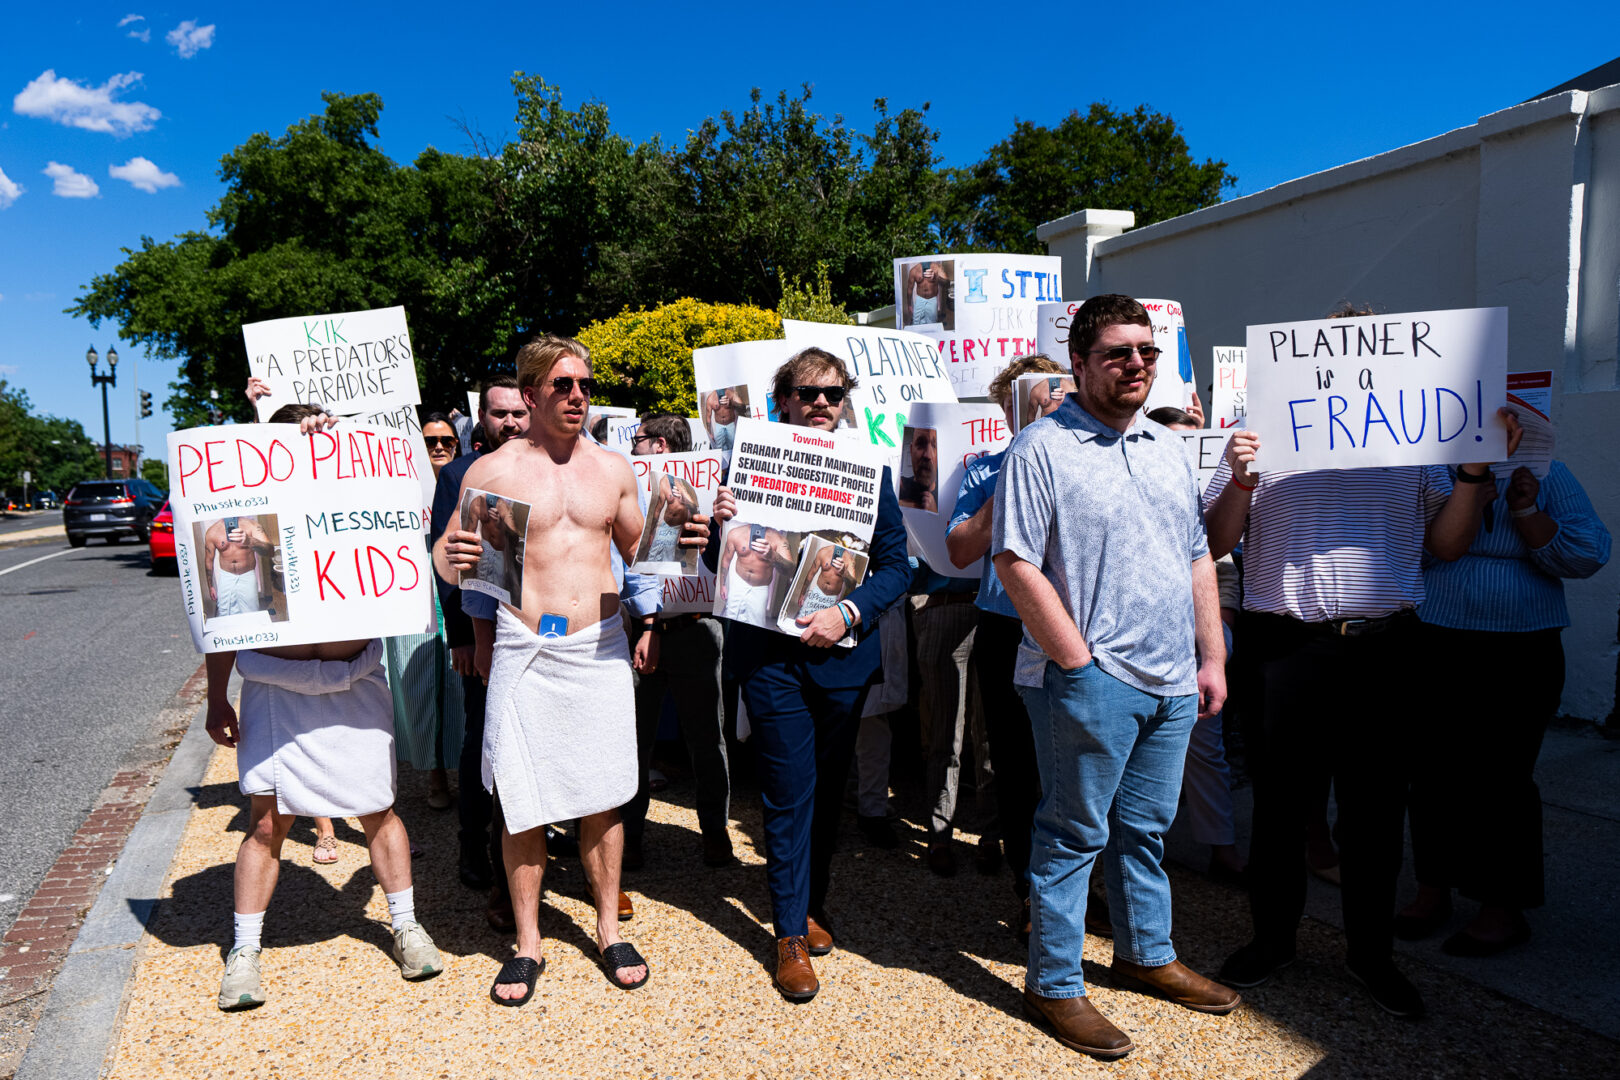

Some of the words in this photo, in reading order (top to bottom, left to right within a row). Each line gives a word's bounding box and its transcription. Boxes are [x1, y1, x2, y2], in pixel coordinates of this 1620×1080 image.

[1002, 268, 1062, 303] STILL
[303, 318, 348, 347] KIK
[979, 307, 1023, 334] JERK
[256, 353, 284, 378] "A
[293, 333, 412, 376] PREDATOR'S
[846, 336, 949, 381] PLATNER
[938, 338, 990, 362] ERY
[997, 338, 1036, 357] TIM
[1216, 349, 1247, 363] WH
[1269, 321, 1442, 363] PLATNER
[293, 363, 399, 406] PARADISE"
[872, 384, 887, 405] IS
[900, 383, 924, 402] ON
[1316, 366, 1335, 390] is
[1358, 368, 1375, 390] a
[1288, 379, 1484, 452] FRAUD!
[792, 432, 835, 450] Townhall
[177, 438, 295, 498] PEDO
[309, 430, 420, 481] PLATNER
[738, 456, 840, 486] SEXUALLY-SUGGESTIVE
[841, 476, 875, 495] PROFILE
[740, 442, 781, 459] GRAHAM
[782, 449, 823, 467] PLATNER
[824, 456, 876, 480] MAINTAINED
[731, 487, 764, 504] KNOWN
[765, 493, 783, 508] FOR
[785, 497, 812, 513] CHILD
[814, 503, 874, 526] EXPLOITATION
[734, 471, 748, 484] ON
[750, 474, 808, 496] 'PREDATOR'S
[809, 485, 855, 505] PARADISE'
[856, 495, 874, 509] APP
[305, 510, 421, 539] MESSAGED
[313, 545, 419, 601] KIDS
